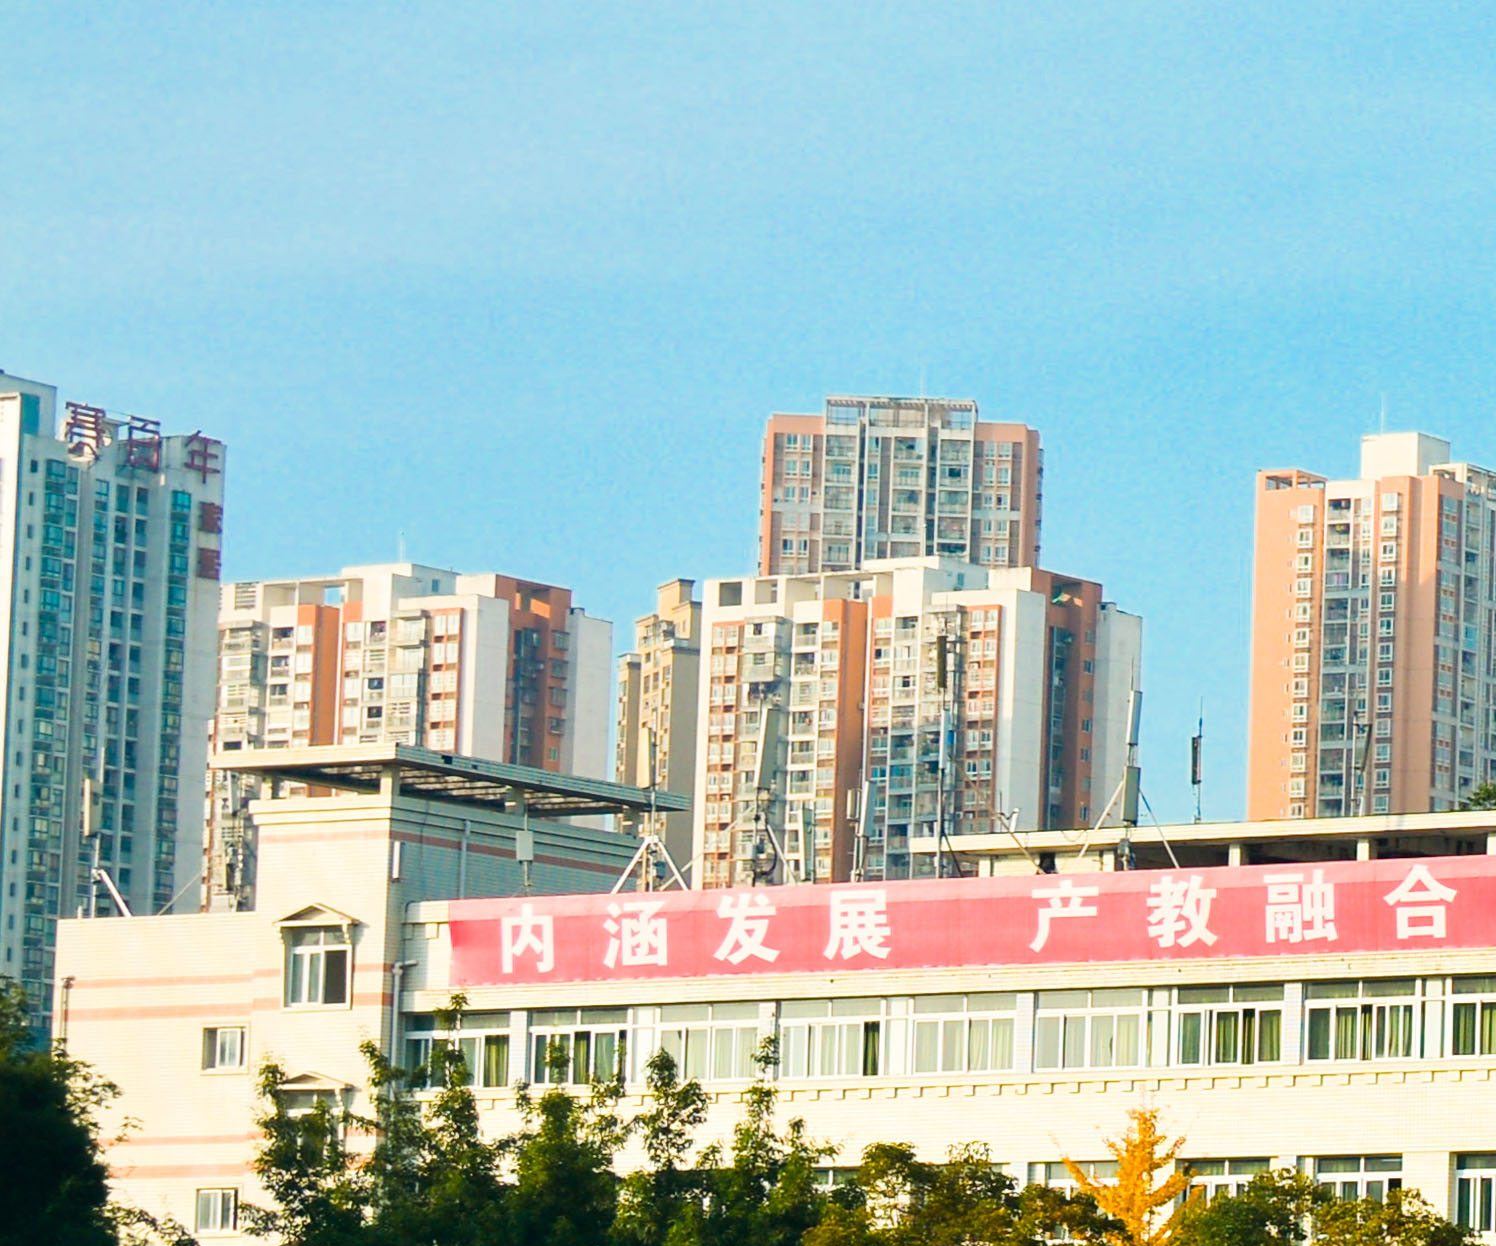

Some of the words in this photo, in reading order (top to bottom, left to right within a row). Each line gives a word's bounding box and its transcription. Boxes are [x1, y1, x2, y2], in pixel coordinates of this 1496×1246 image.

[500, 889, 891, 974] 内涵发展
[1029, 864, 1457, 952] 产教融合
